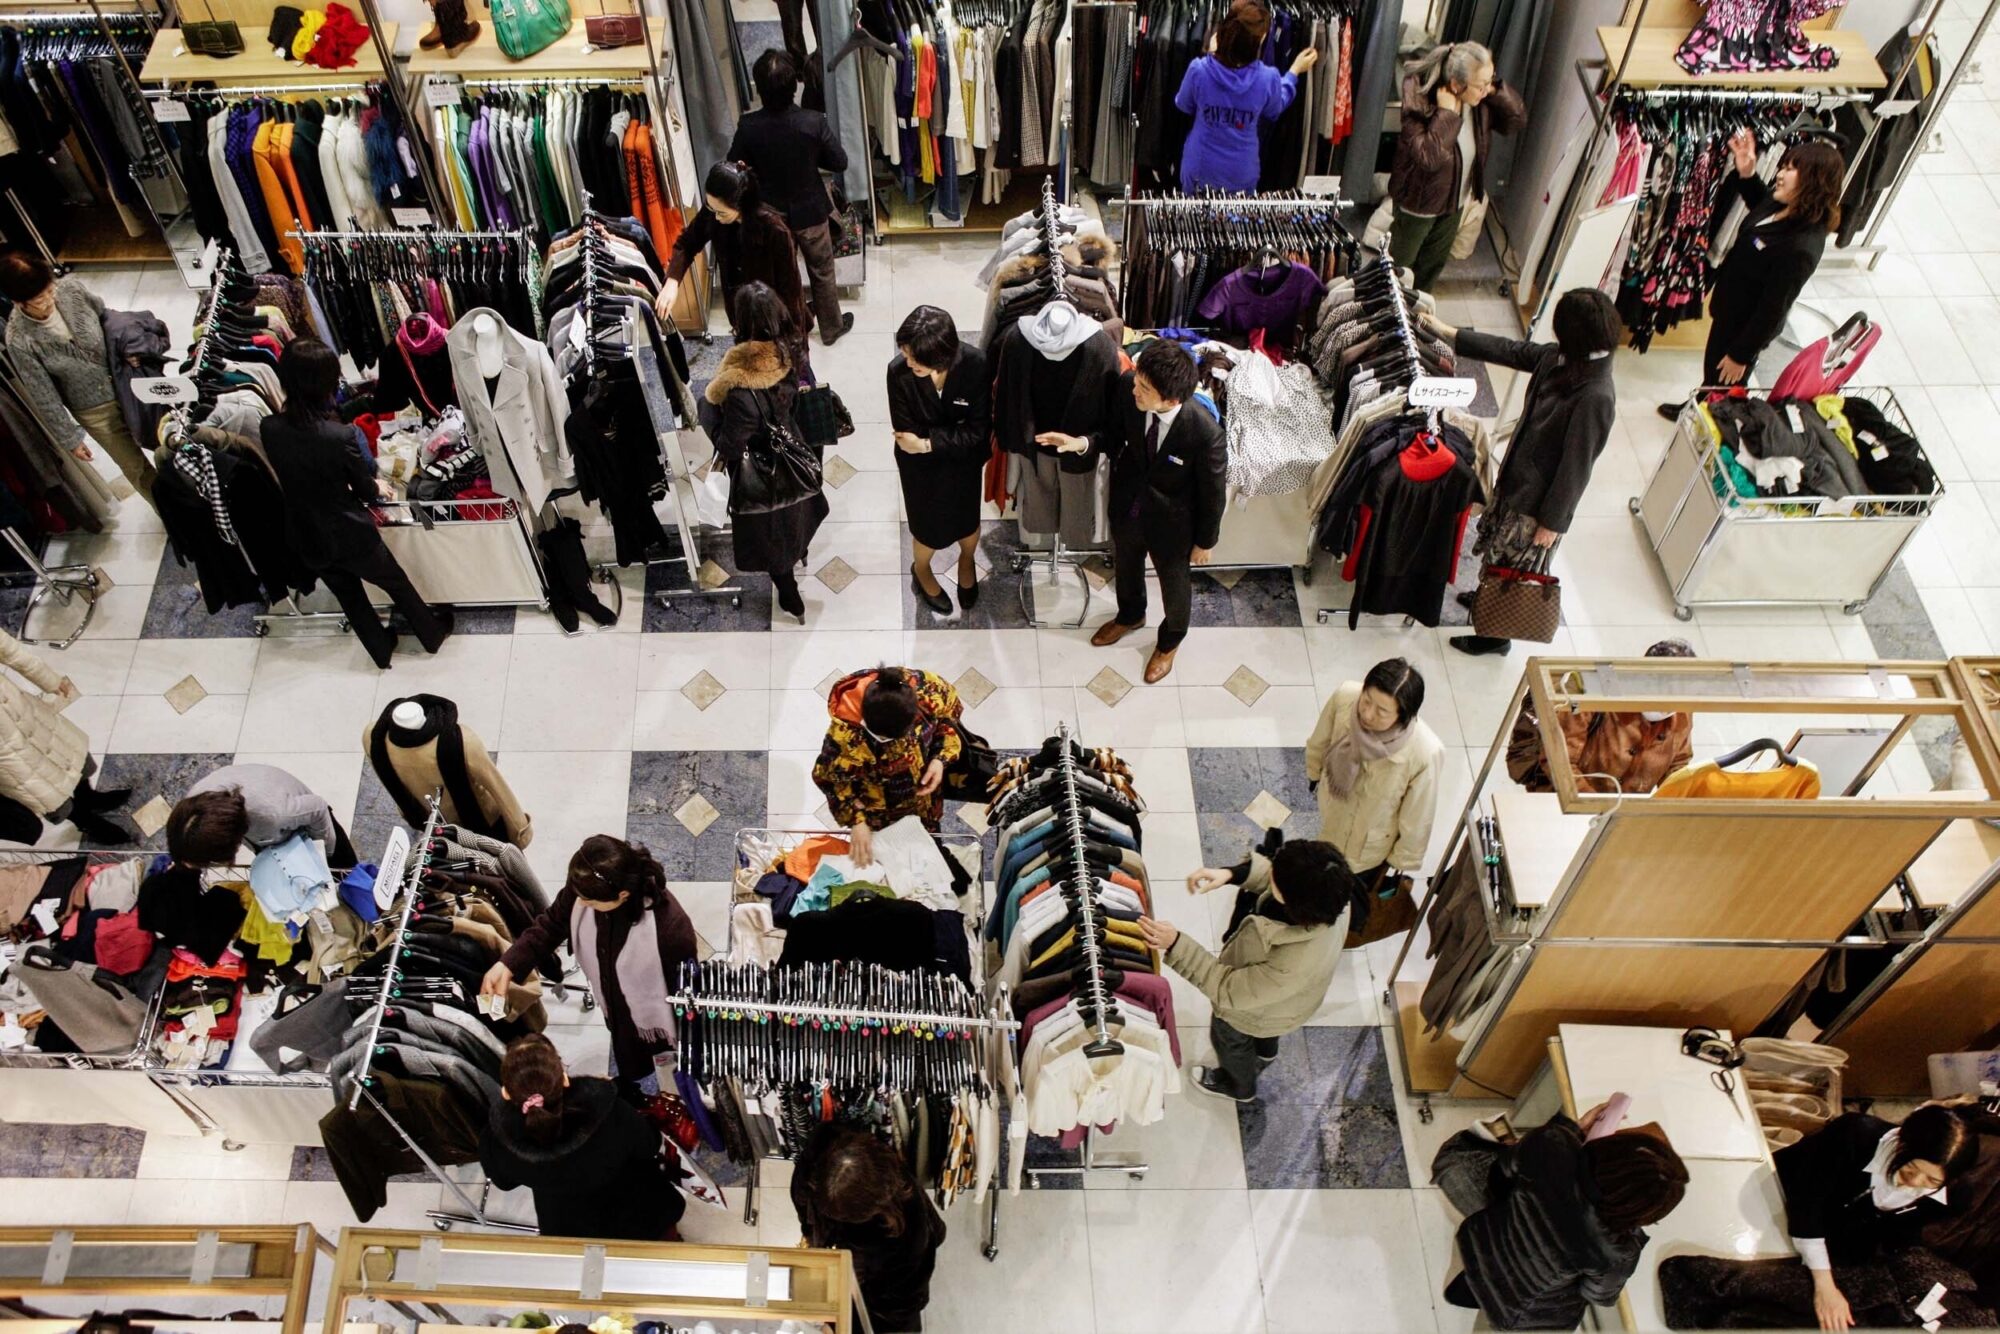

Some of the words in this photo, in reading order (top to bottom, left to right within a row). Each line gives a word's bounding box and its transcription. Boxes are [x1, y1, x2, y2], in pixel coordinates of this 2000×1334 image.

[1415, 387, 1470, 397] Lサイズコーナー
